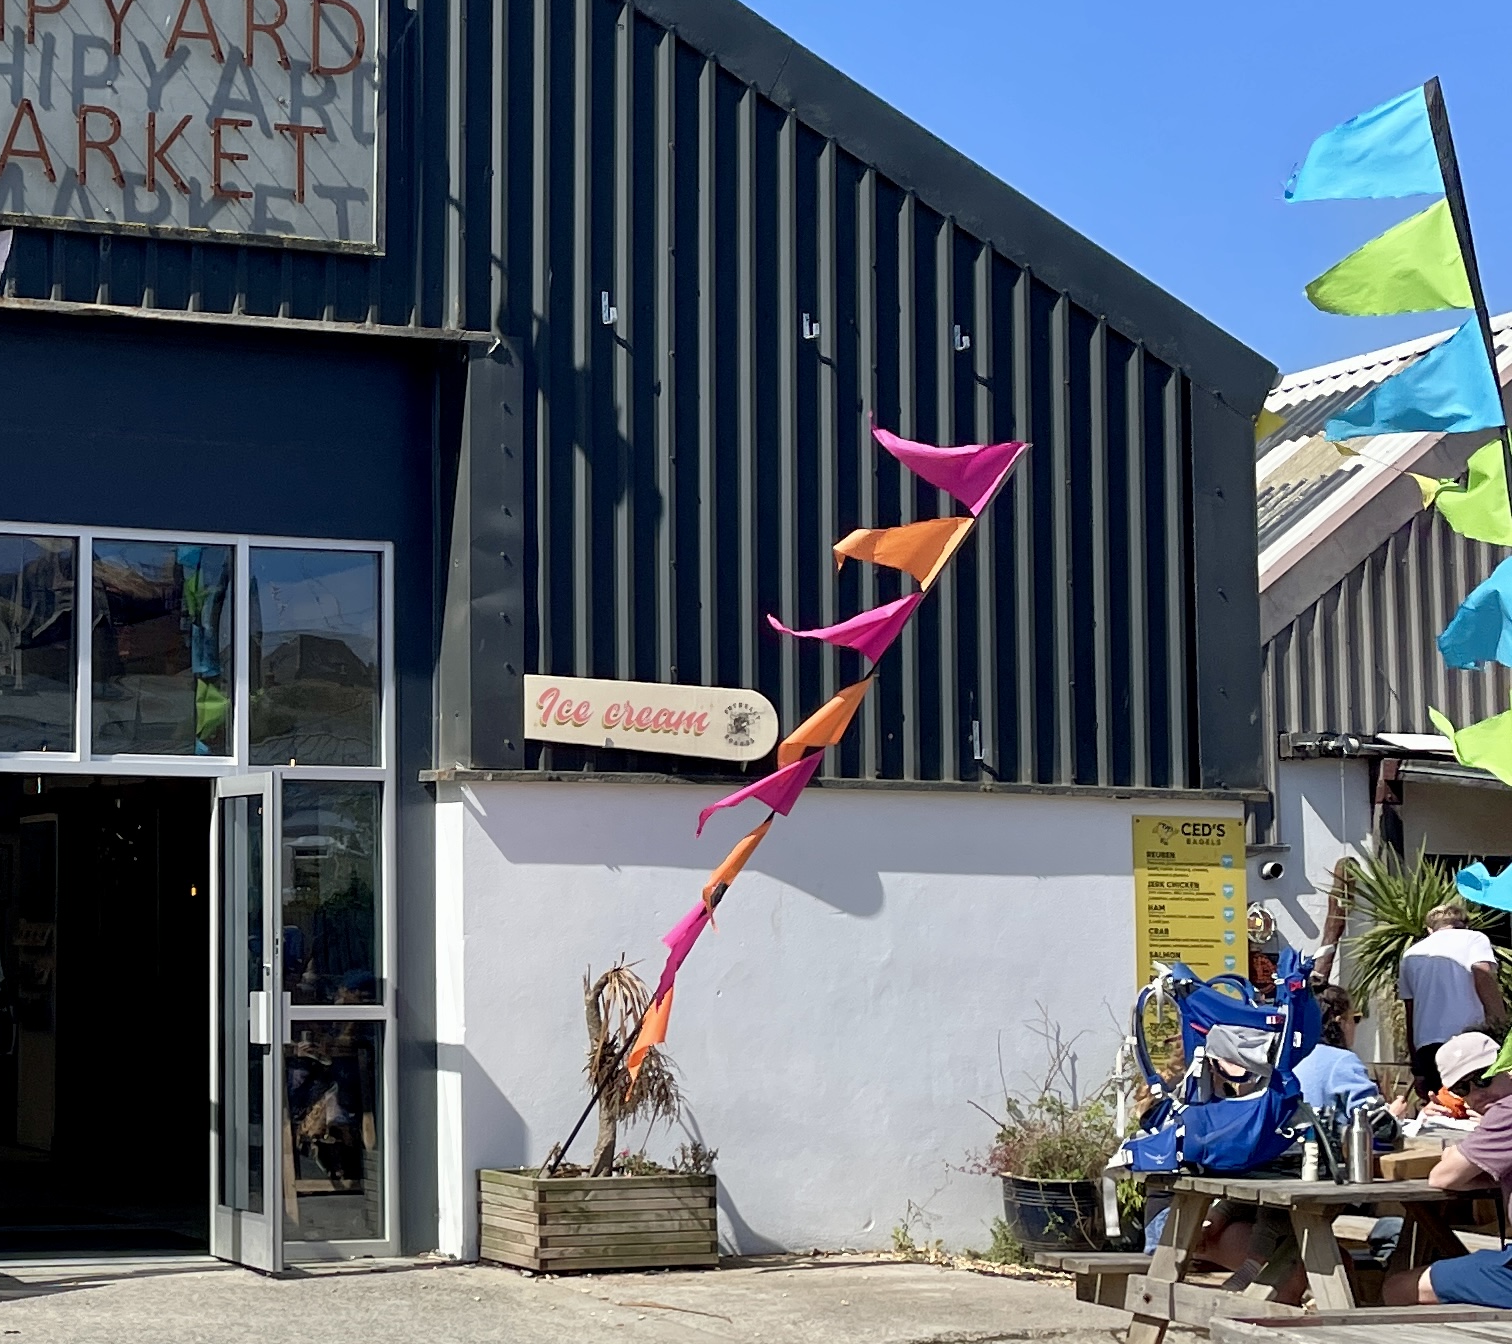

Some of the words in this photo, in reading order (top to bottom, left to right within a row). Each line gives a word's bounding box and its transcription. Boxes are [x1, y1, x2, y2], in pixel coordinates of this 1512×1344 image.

[536, 687, 594, 727] Ice
[601, 700, 710, 737] cream
[1181, 822, 1226, 838] CED'S
[1186, 838, 1222, 846] BAGELS
[1166, 881, 1200, 890] CHICKEN
[1149, 951, 1181, 959] SALMON
